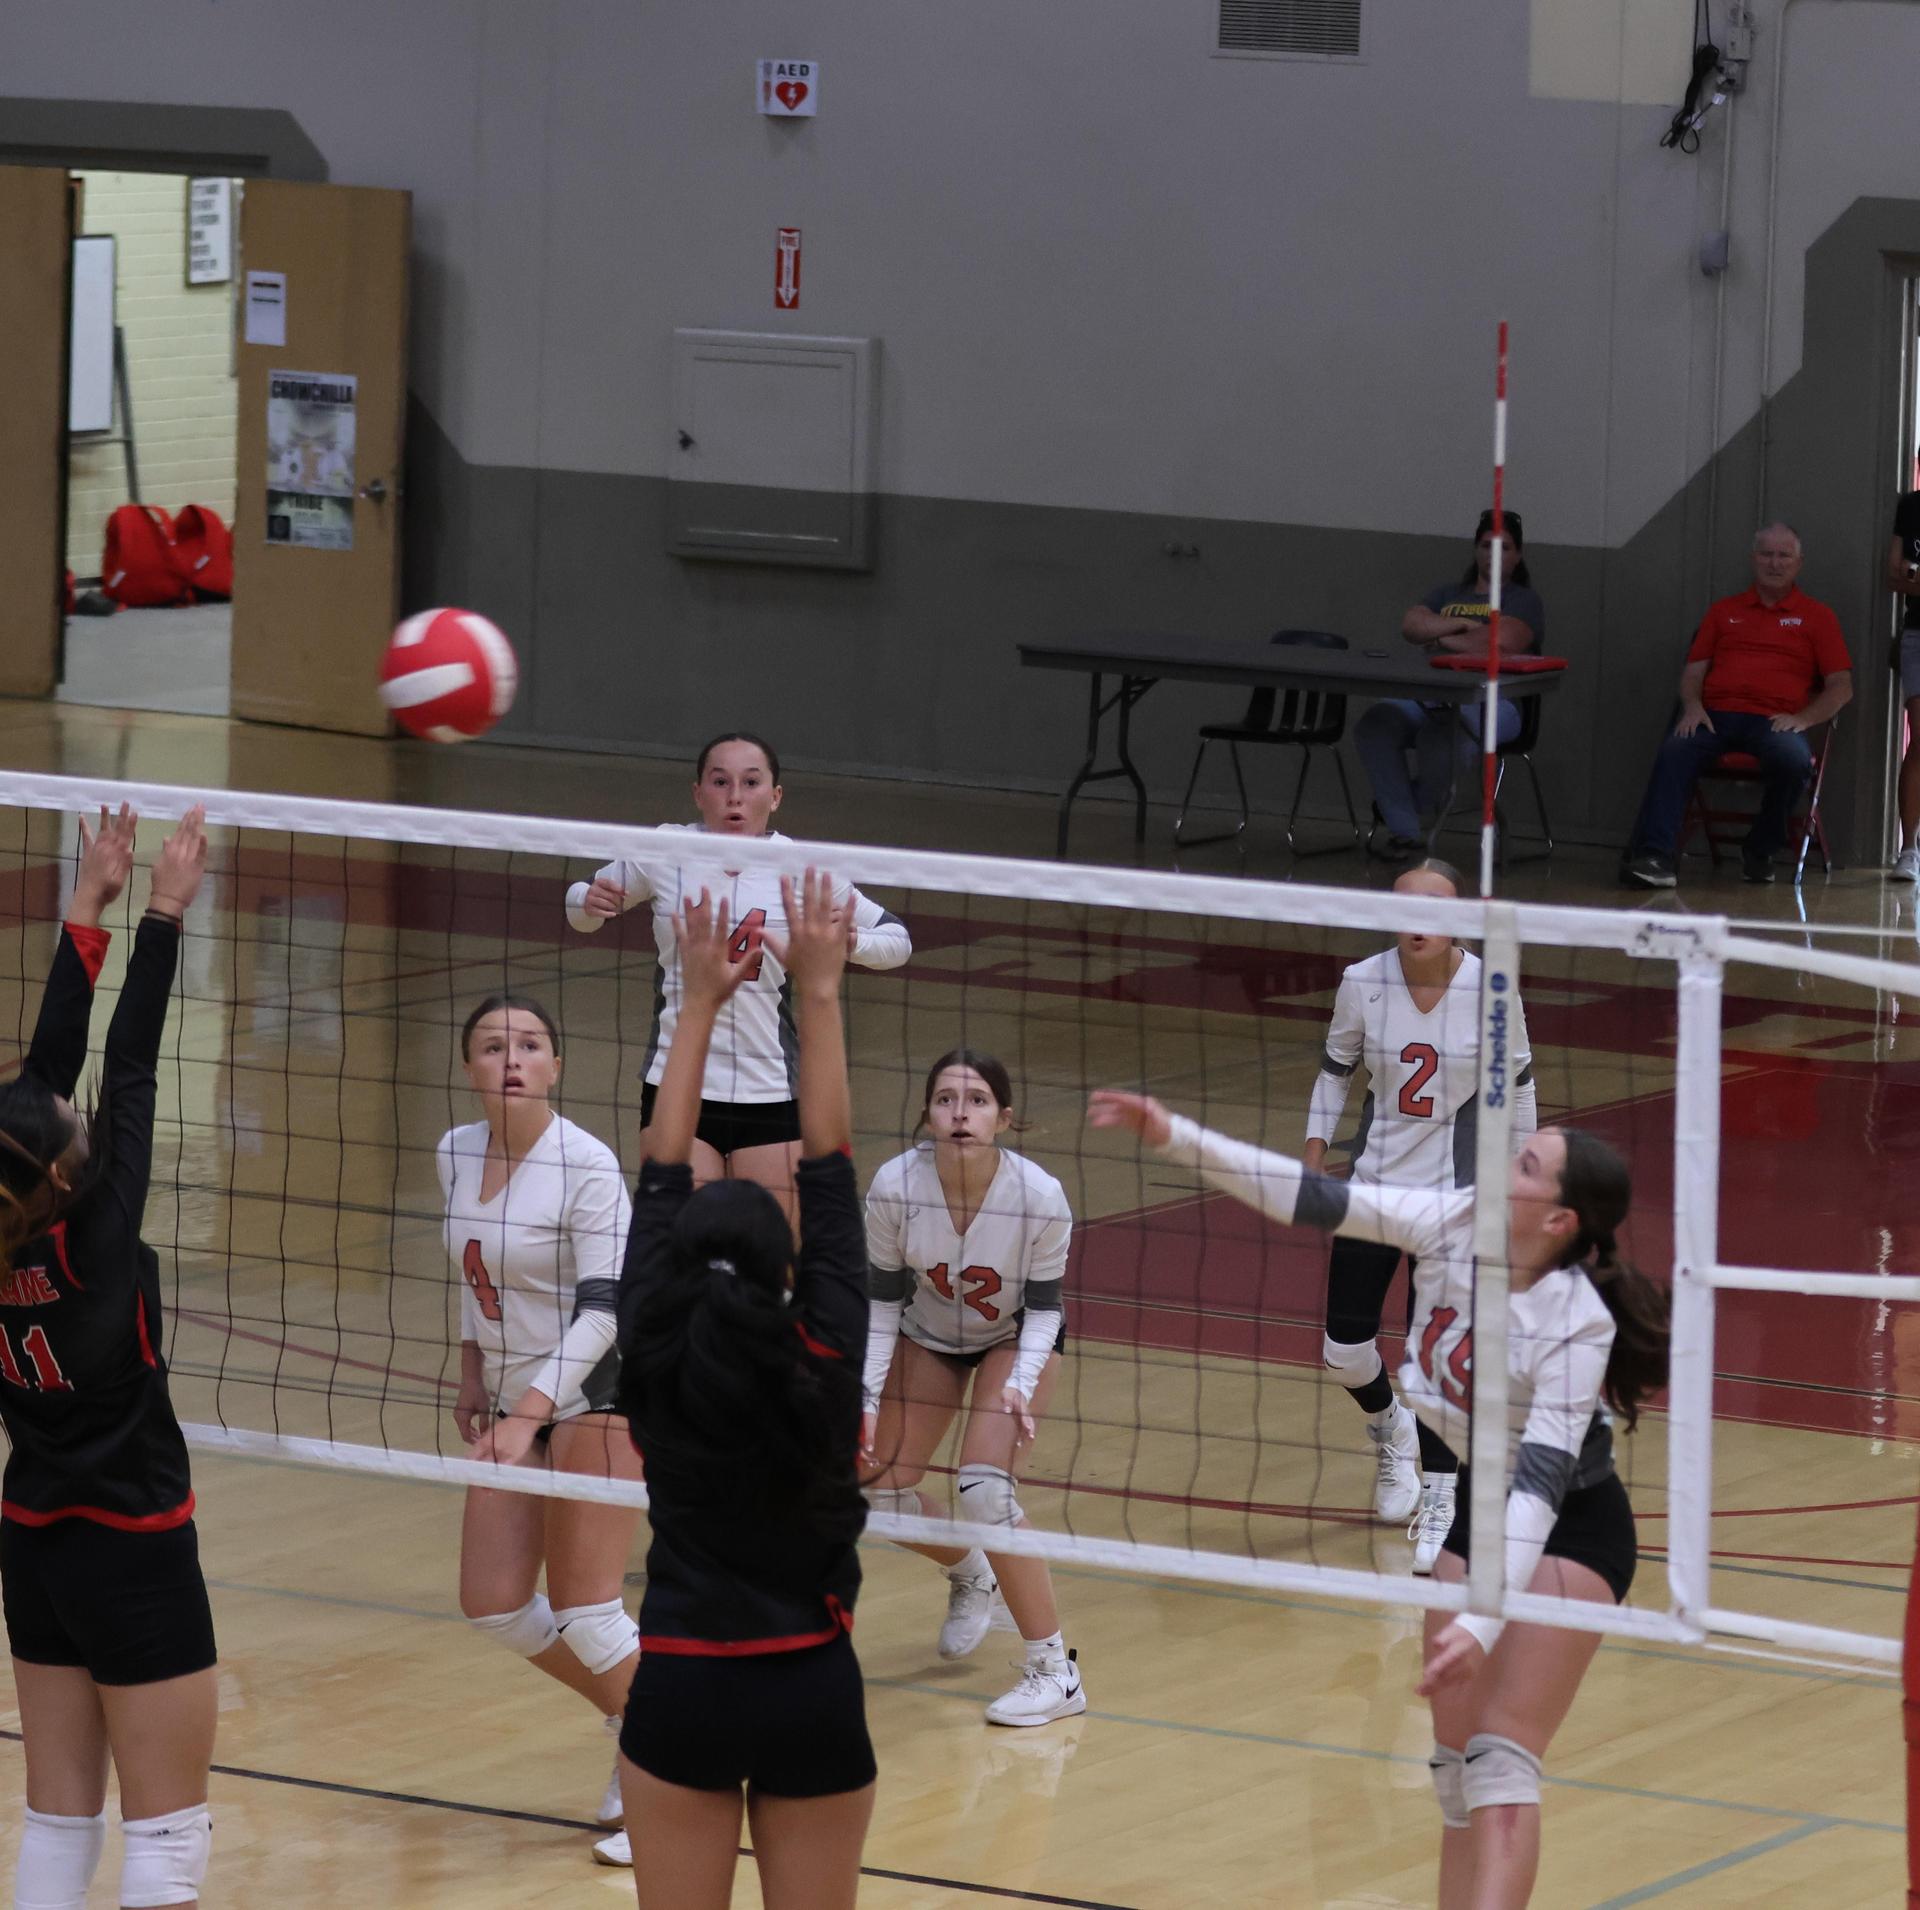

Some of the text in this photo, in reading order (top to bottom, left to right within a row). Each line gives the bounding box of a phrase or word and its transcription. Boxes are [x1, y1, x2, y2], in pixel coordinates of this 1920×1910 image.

[776, 63, 810, 77] AED
[1399, 1042, 1439, 1118] 2
[1487, 999, 1508, 1108] Schelde
[463, 1239, 503, 1321] 4
[926, 1262, 1002, 1321] 12
[0, 1323, 75, 1393] 11
